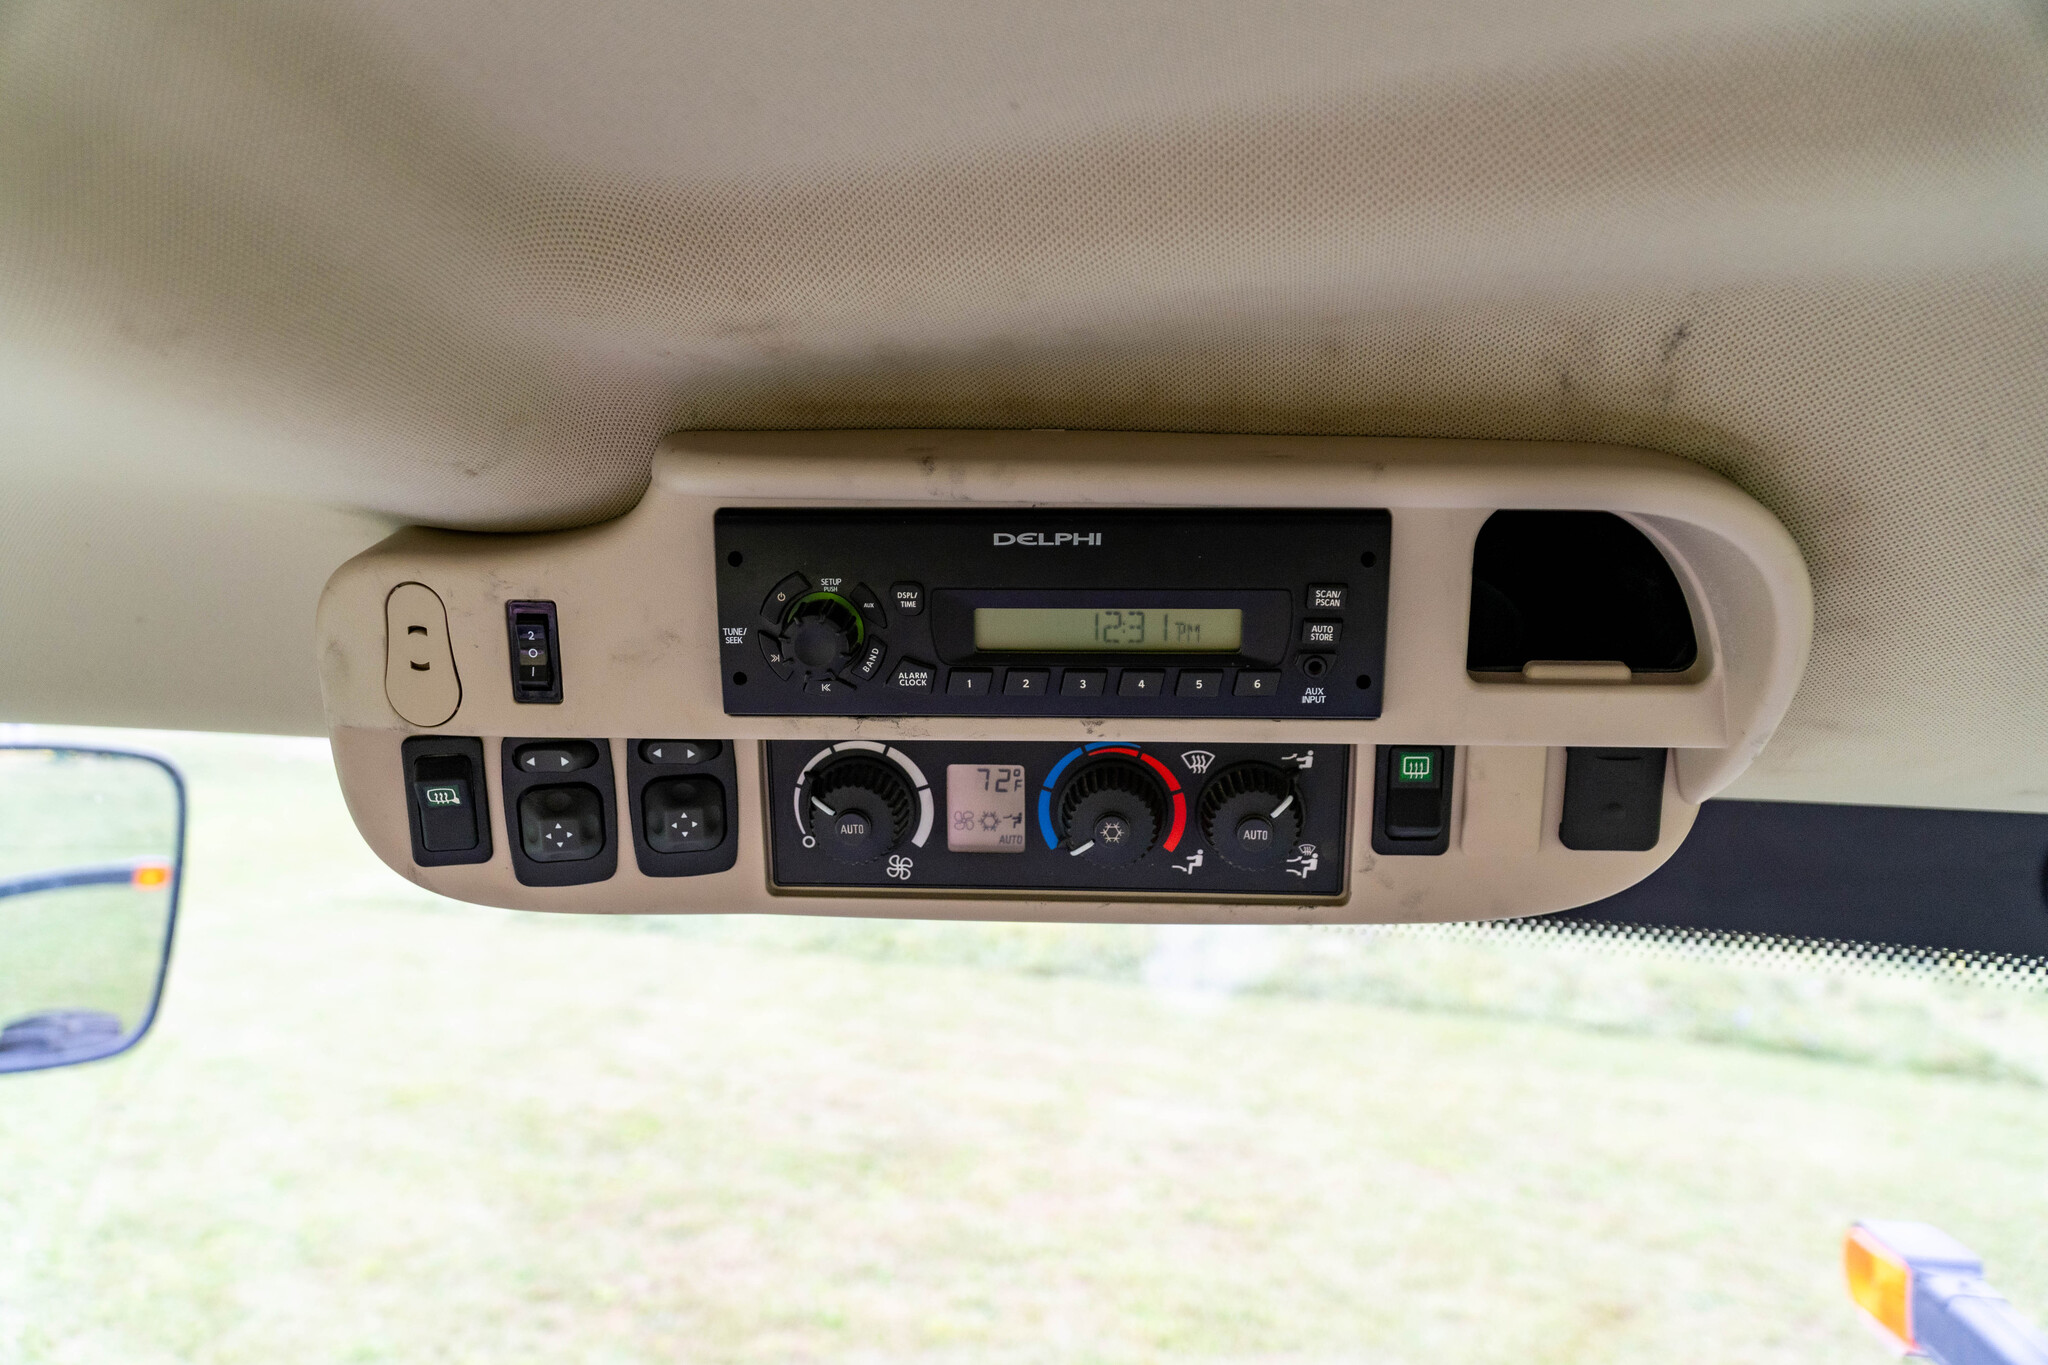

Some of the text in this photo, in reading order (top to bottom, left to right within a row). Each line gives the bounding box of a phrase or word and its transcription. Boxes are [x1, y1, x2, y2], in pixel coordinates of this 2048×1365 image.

[993, 532, 1102, 546] DELPHI
[820, 577, 842, 586] SETUP
[897, 591, 918, 599] DSPL/
[1315, 590, 1342, 598] SCAN/
[900, 600, 917, 608] TIME
[1315, 599, 1341, 607] PSCAN
[722, 627, 747, 636] TUNE/
[1095, 611, 1169, 644] 12:31
[1311, 625, 1334, 633] AUTO
[527, 631, 535, 640] 2
[725, 636, 743, 644] SEEK
[1310, 633, 1334, 641] STORE
[862, 647, 880, 673] BAND
[899, 679, 927, 687] CLOCK
[967, 679, 972, 688] 1
[1022, 679, 1030, 688] 2
[1079, 679, 1086, 689] 3
[1137, 679, 1145, 689] 4
[1195, 679, 1203, 689] 5
[1253, 679, 1261, 689] 6
[1305, 687, 1324, 695] AUX
[1301, 695, 1326, 704] INPUT
[840, 824, 864, 835] AUTO
[999, 835, 1023, 845] AUTO
[1243, 830, 1268, 841] AUTO
